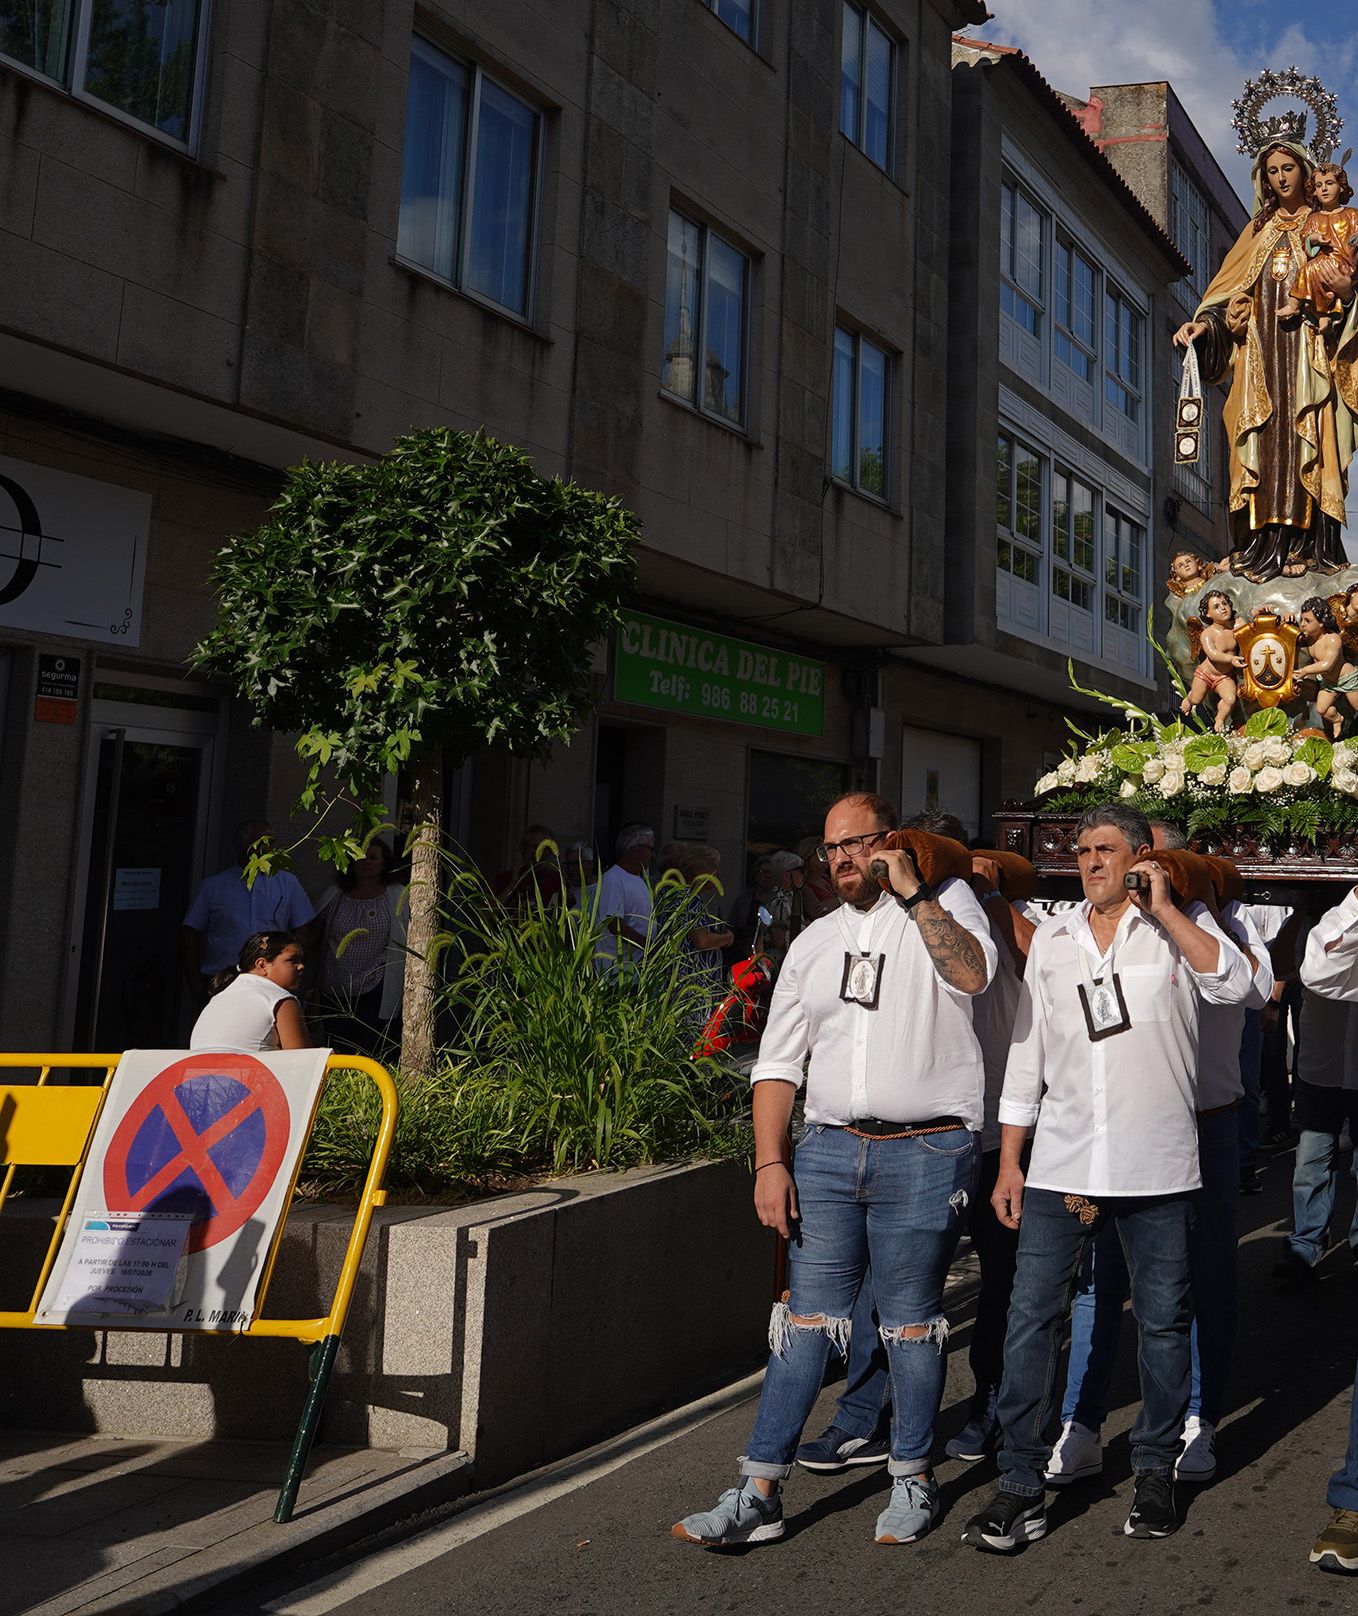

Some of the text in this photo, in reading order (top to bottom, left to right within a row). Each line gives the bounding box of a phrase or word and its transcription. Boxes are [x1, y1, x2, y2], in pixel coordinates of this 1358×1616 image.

[621, 620, 822, 696] CLINICA DEL PIE
[649, 670, 800, 723] Telf: 986 88 25 21
[125, 1237, 177, 1248] ESTACIONAR
[183, 1308, 195, 1322] P.
[195, 1309, 205, 1322] L.
